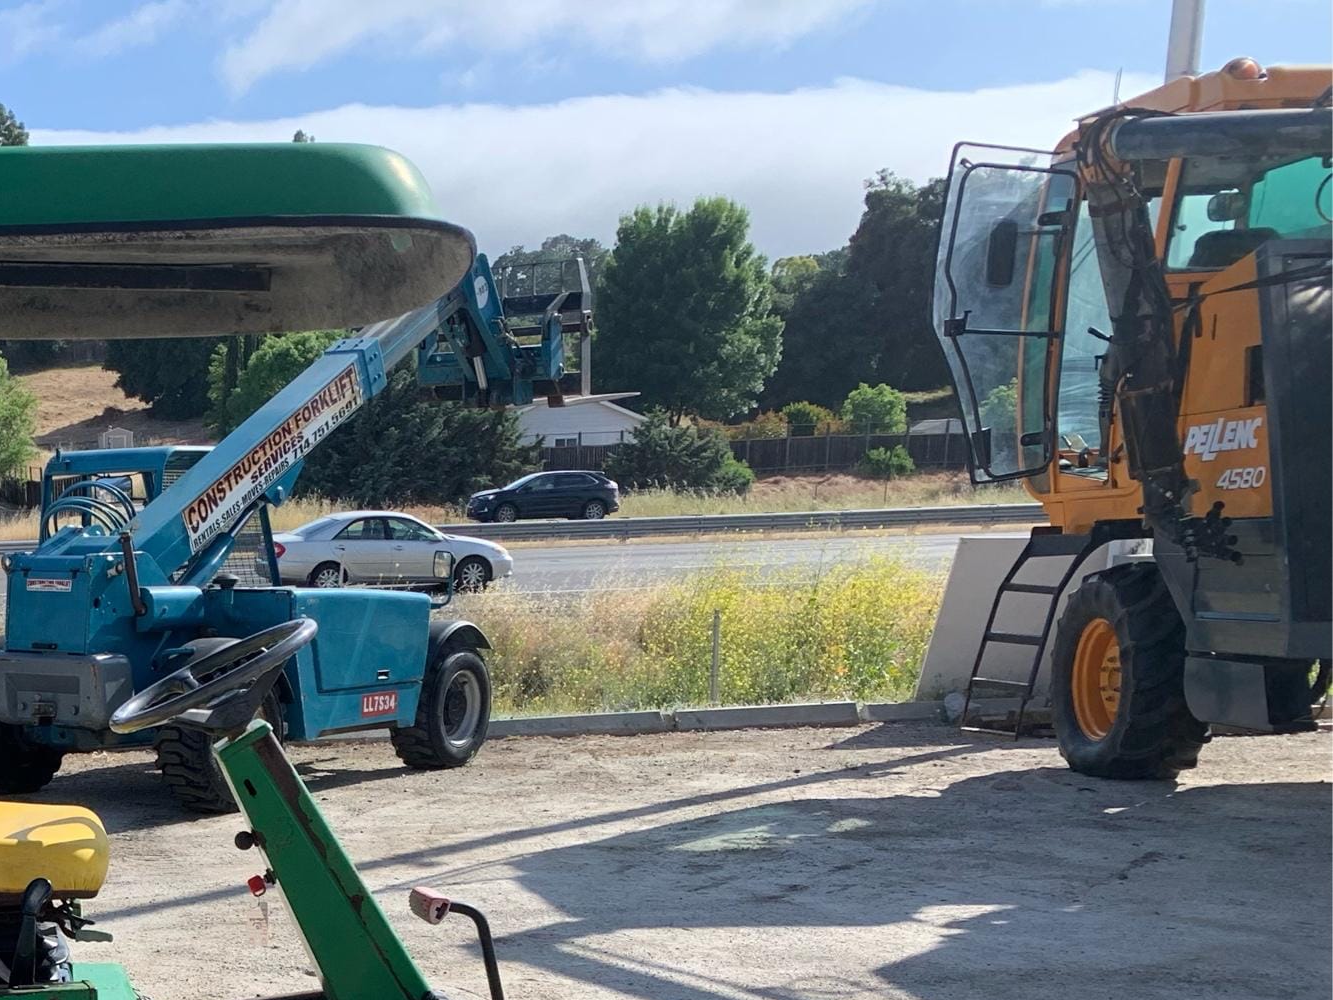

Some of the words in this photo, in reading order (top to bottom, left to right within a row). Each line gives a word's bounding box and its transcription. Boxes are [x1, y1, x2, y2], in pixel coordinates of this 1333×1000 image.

[188, 421, 293, 534] CONSTRUCTION
[295, 367, 355, 430] FORKLIFT
[251, 431, 305, 484] SERVICES
[1183, 416, 1264, 462] PELLENC
[1215, 465, 1266, 489] 4580
